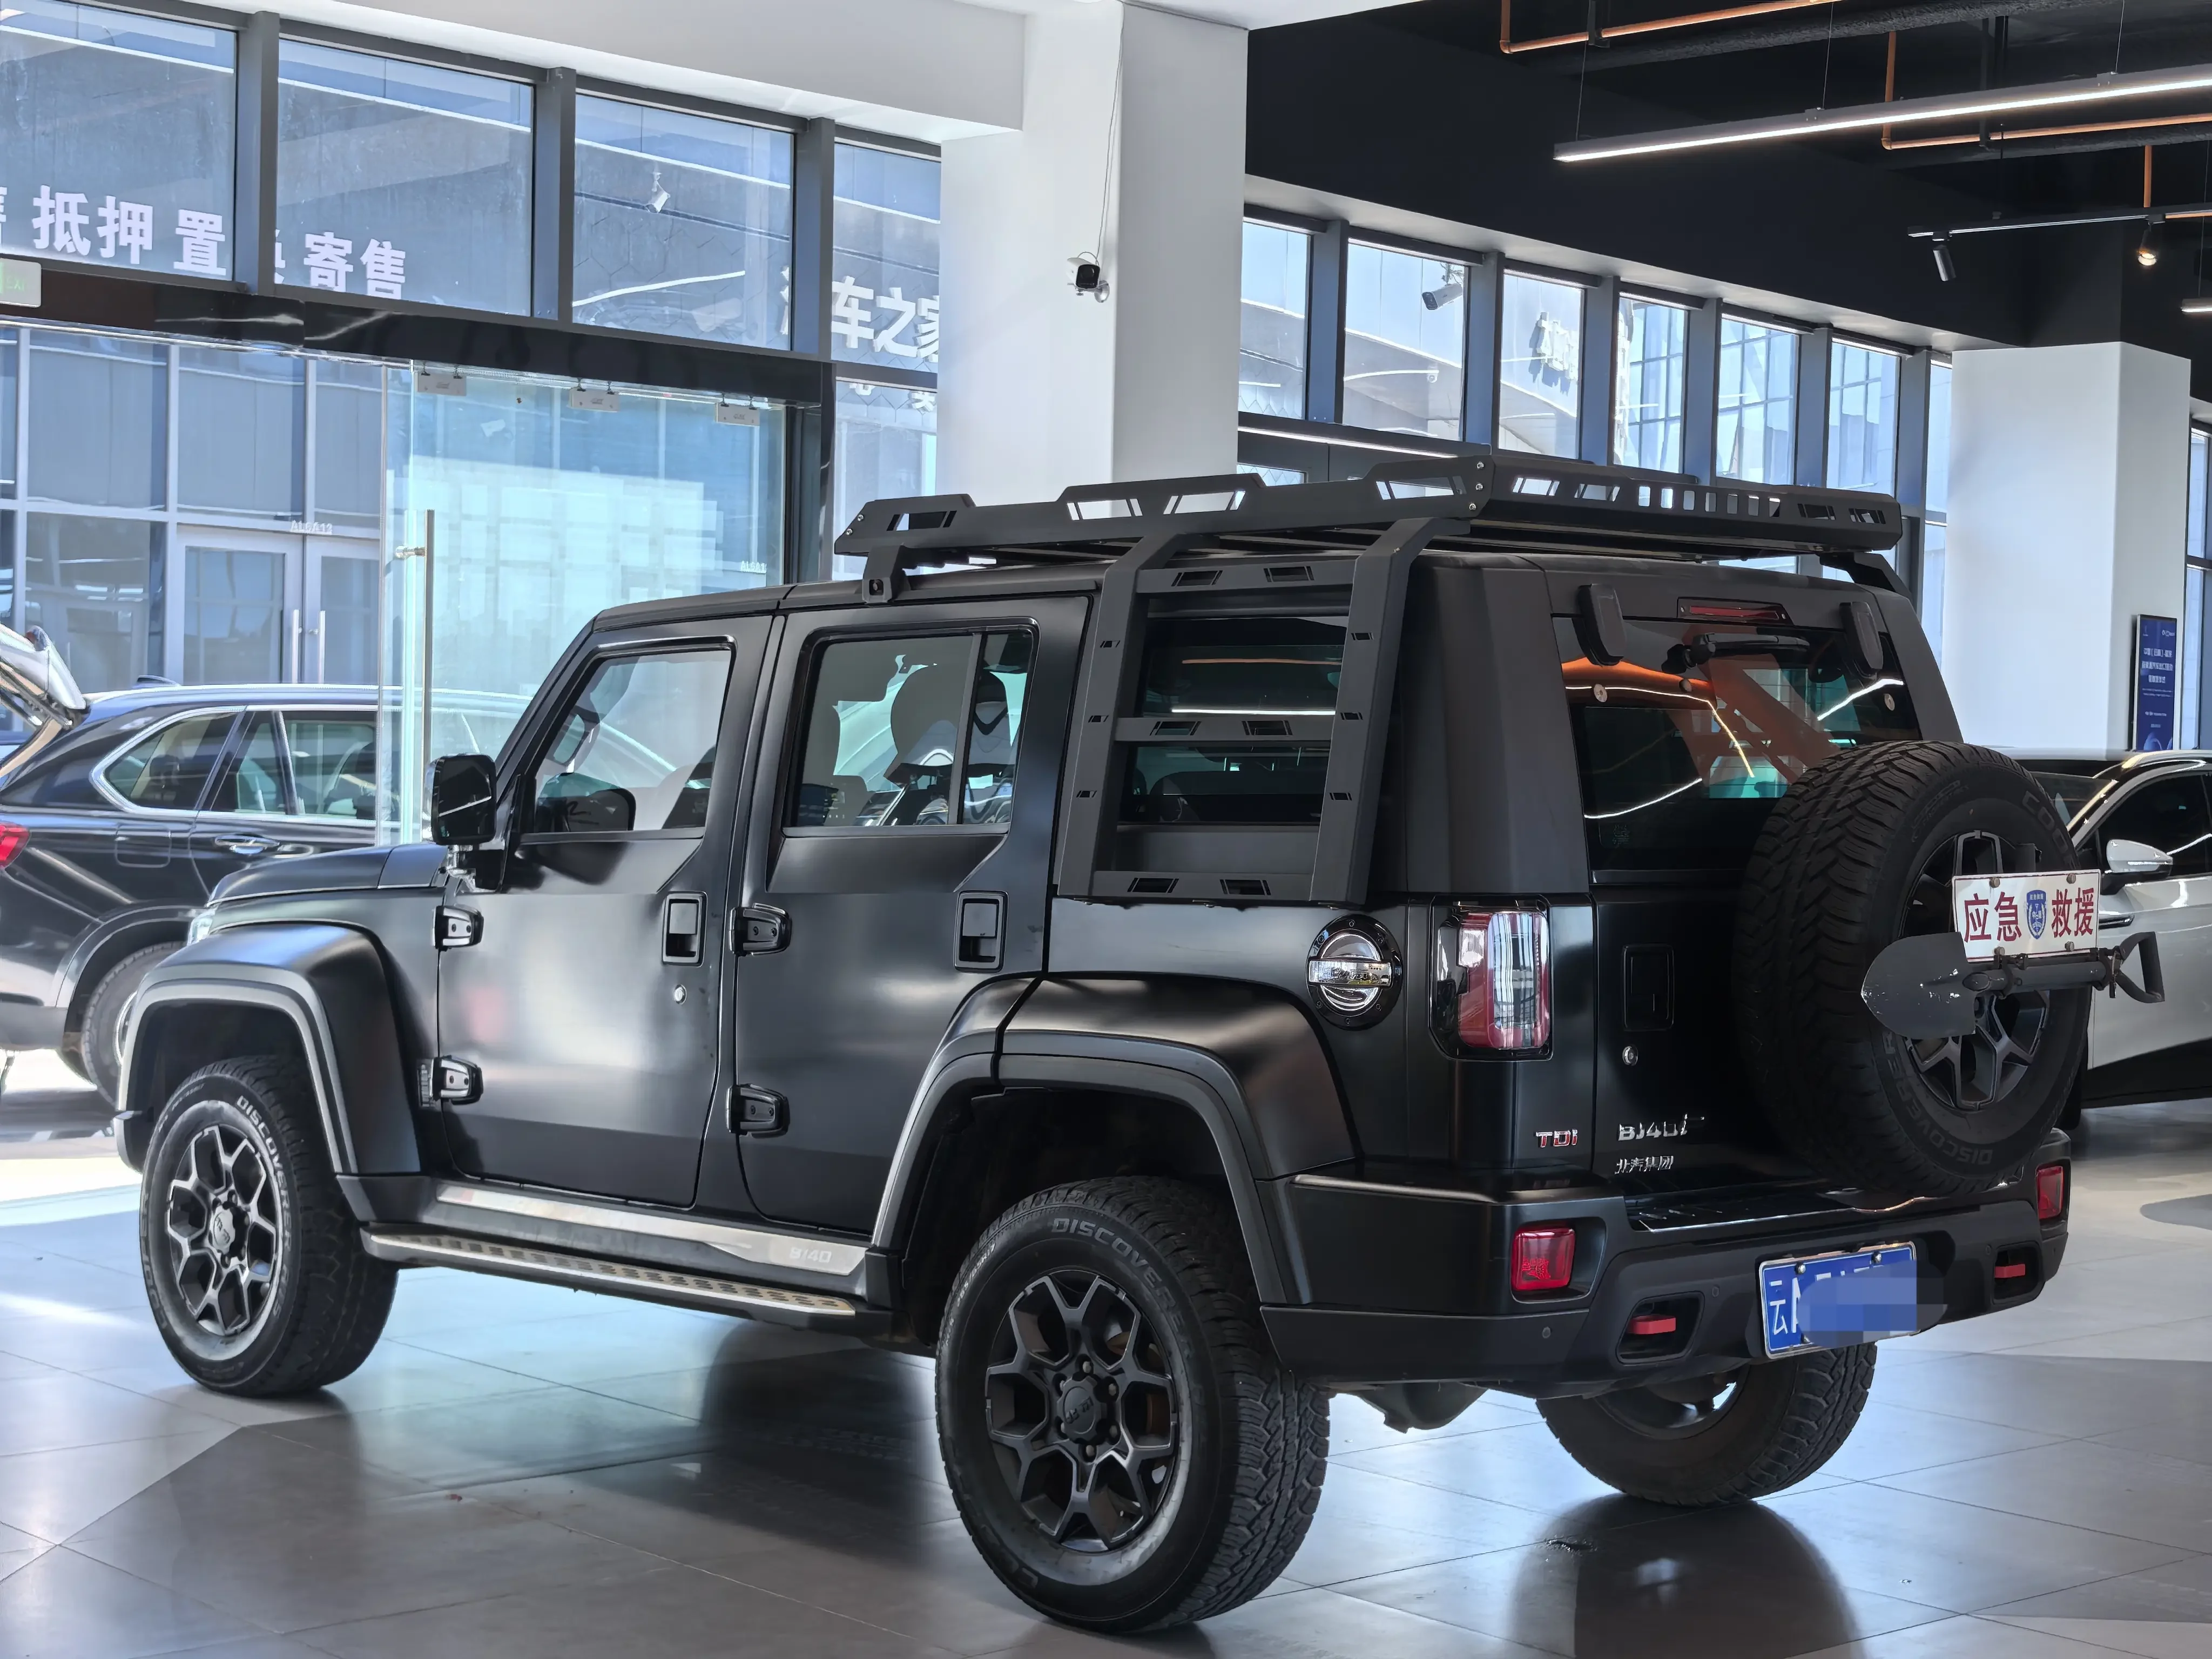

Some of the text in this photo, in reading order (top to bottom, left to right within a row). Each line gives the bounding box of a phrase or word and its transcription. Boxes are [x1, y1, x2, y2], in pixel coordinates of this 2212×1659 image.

[32, 185, 153, 265] 抵押
[304, 232, 406, 300] 寄售
[780, 266, 939, 363] 车之家
[1964, 887, 2094, 943] 应急 救援
[1614, 1155, 1674, 1175] 北汽集团
